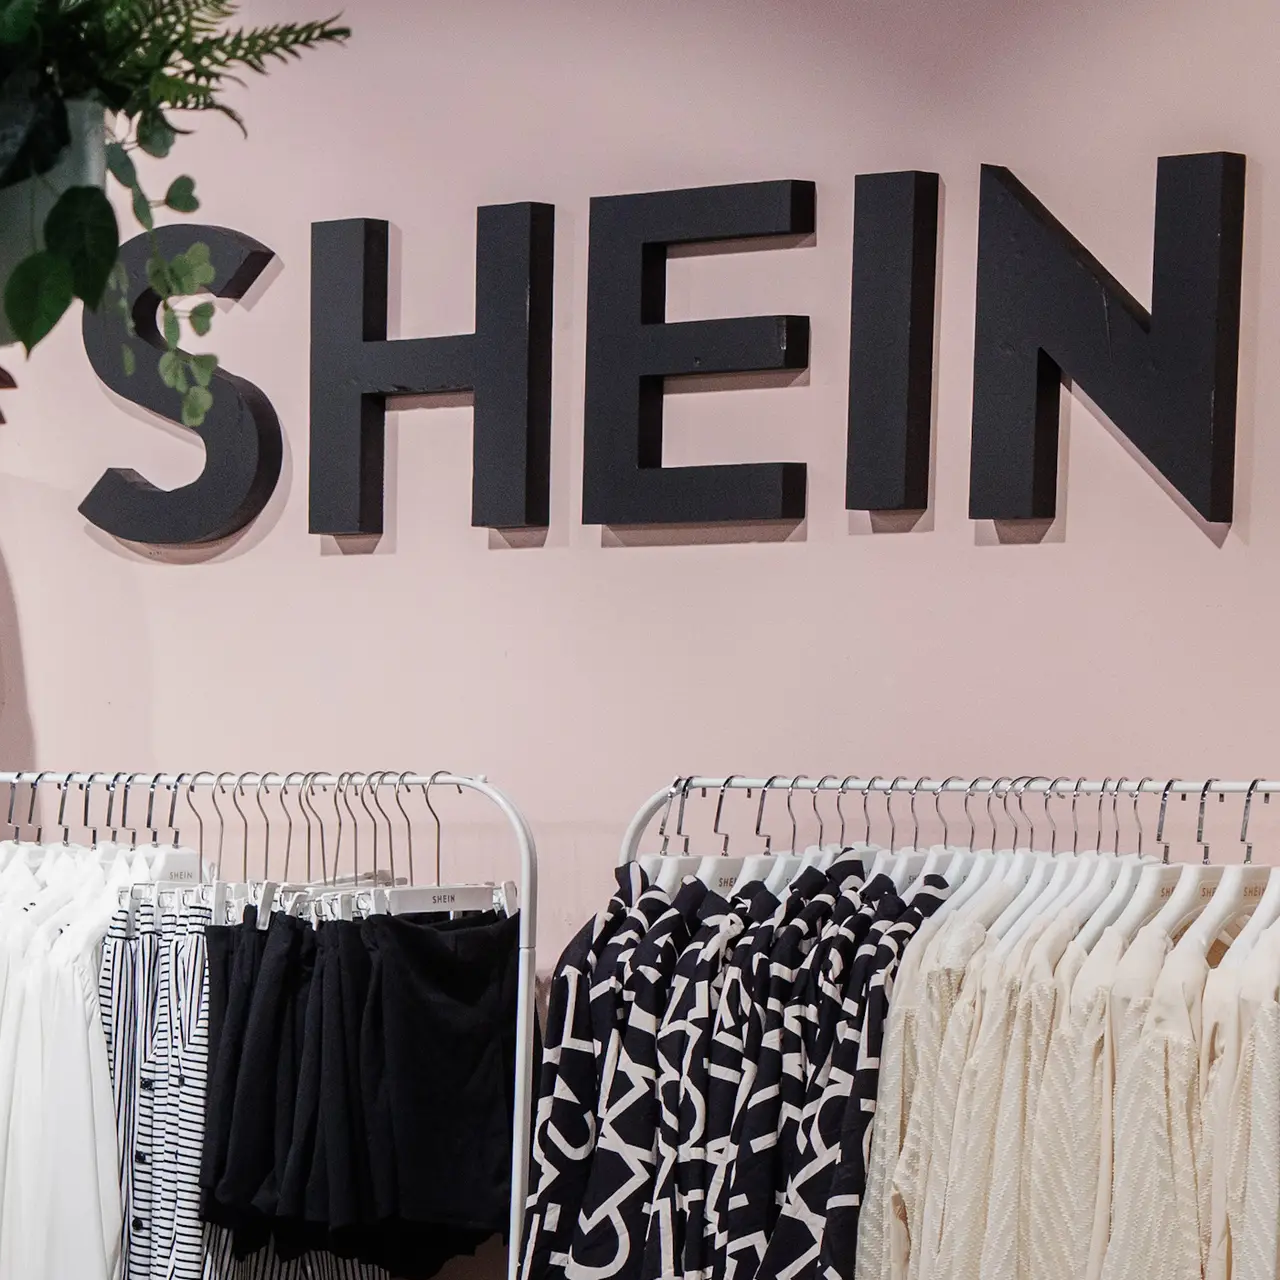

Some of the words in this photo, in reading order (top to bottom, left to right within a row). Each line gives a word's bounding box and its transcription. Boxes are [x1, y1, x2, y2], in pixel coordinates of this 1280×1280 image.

[77, 151, 1246, 544] SHEIN
[169, 871, 193, 880] SHEIN
[432, 894, 456, 904] SHEIN
